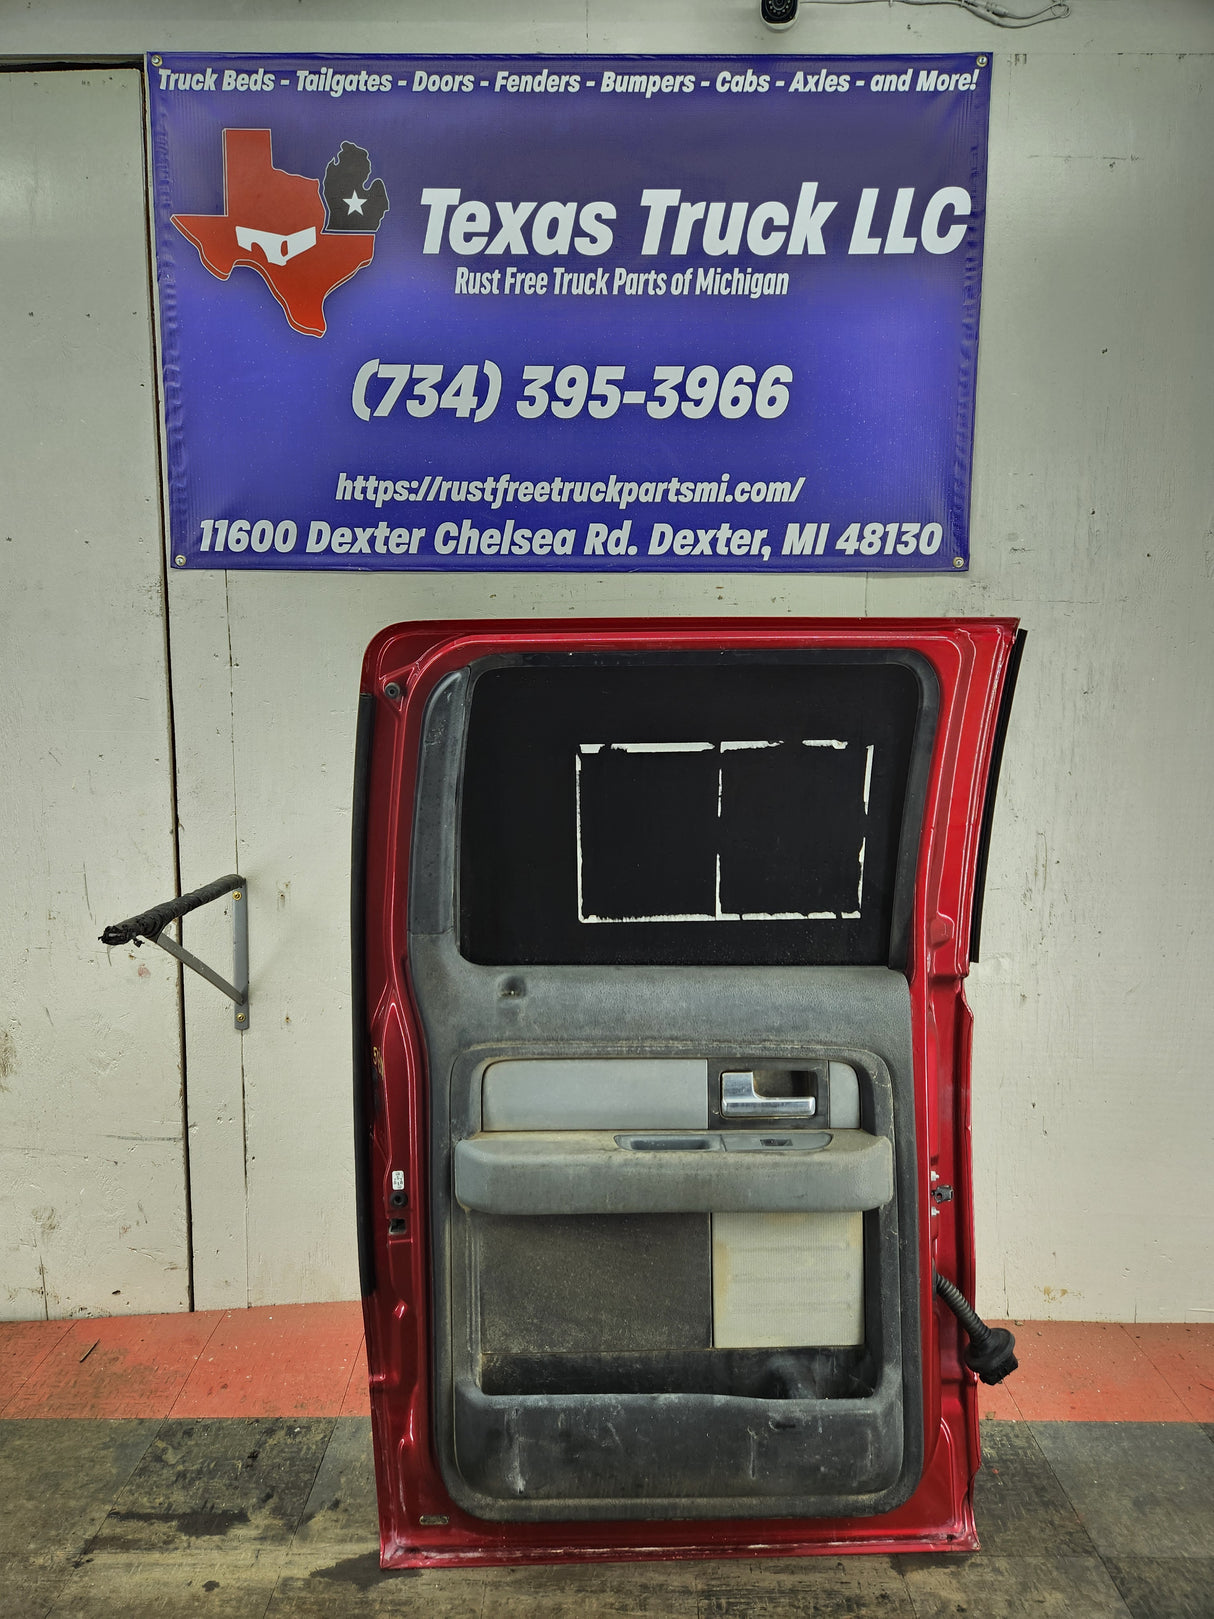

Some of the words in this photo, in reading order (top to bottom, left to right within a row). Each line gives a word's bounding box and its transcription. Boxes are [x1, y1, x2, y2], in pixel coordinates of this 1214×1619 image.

[158, 67, 217, 91] Truck
[221, 69, 276, 91] Beds
[296, 66, 393, 98] Tailgates
[412, 70, 475, 93] Doors
[494, 68, 581, 93] Fenders
[600, 70, 696, 99] Bumpers
[715, 68, 771, 93] Cabs
[788, 68, 851, 93] Axles
[870, 68, 914, 92] and
[915, 69, 980, 92] More!
[420, 187, 617, 256] Texas
[639, 181, 839, 257] Truck
[847, 185, 972, 255] LLC
[454, 266, 502, 295] Rust
[503, 266, 549, 295] Free
[552, 267, 610, 296] Truck
[612, 267, 668, 296] Parts
[670, 267, 694, 296] of
[694, 267, 790, 299] Michigan
[351, 358, 502, 423] (734)
[516, 364, 794, 420] 395-3966
[335, 472, 807, 510] https://rustfreetruckpartsmi.com/
[199, 519, 298, 553] 11600
[305, 520, 427, 555] Dexter
[434, 519, 577, 555] Chelsea
[583, 520, 638, 556] Rd.
[647, 522, 772, 562] Dexter,
[781, 522, 831, 556] MI
[834, 522, 944, 556] 48130
